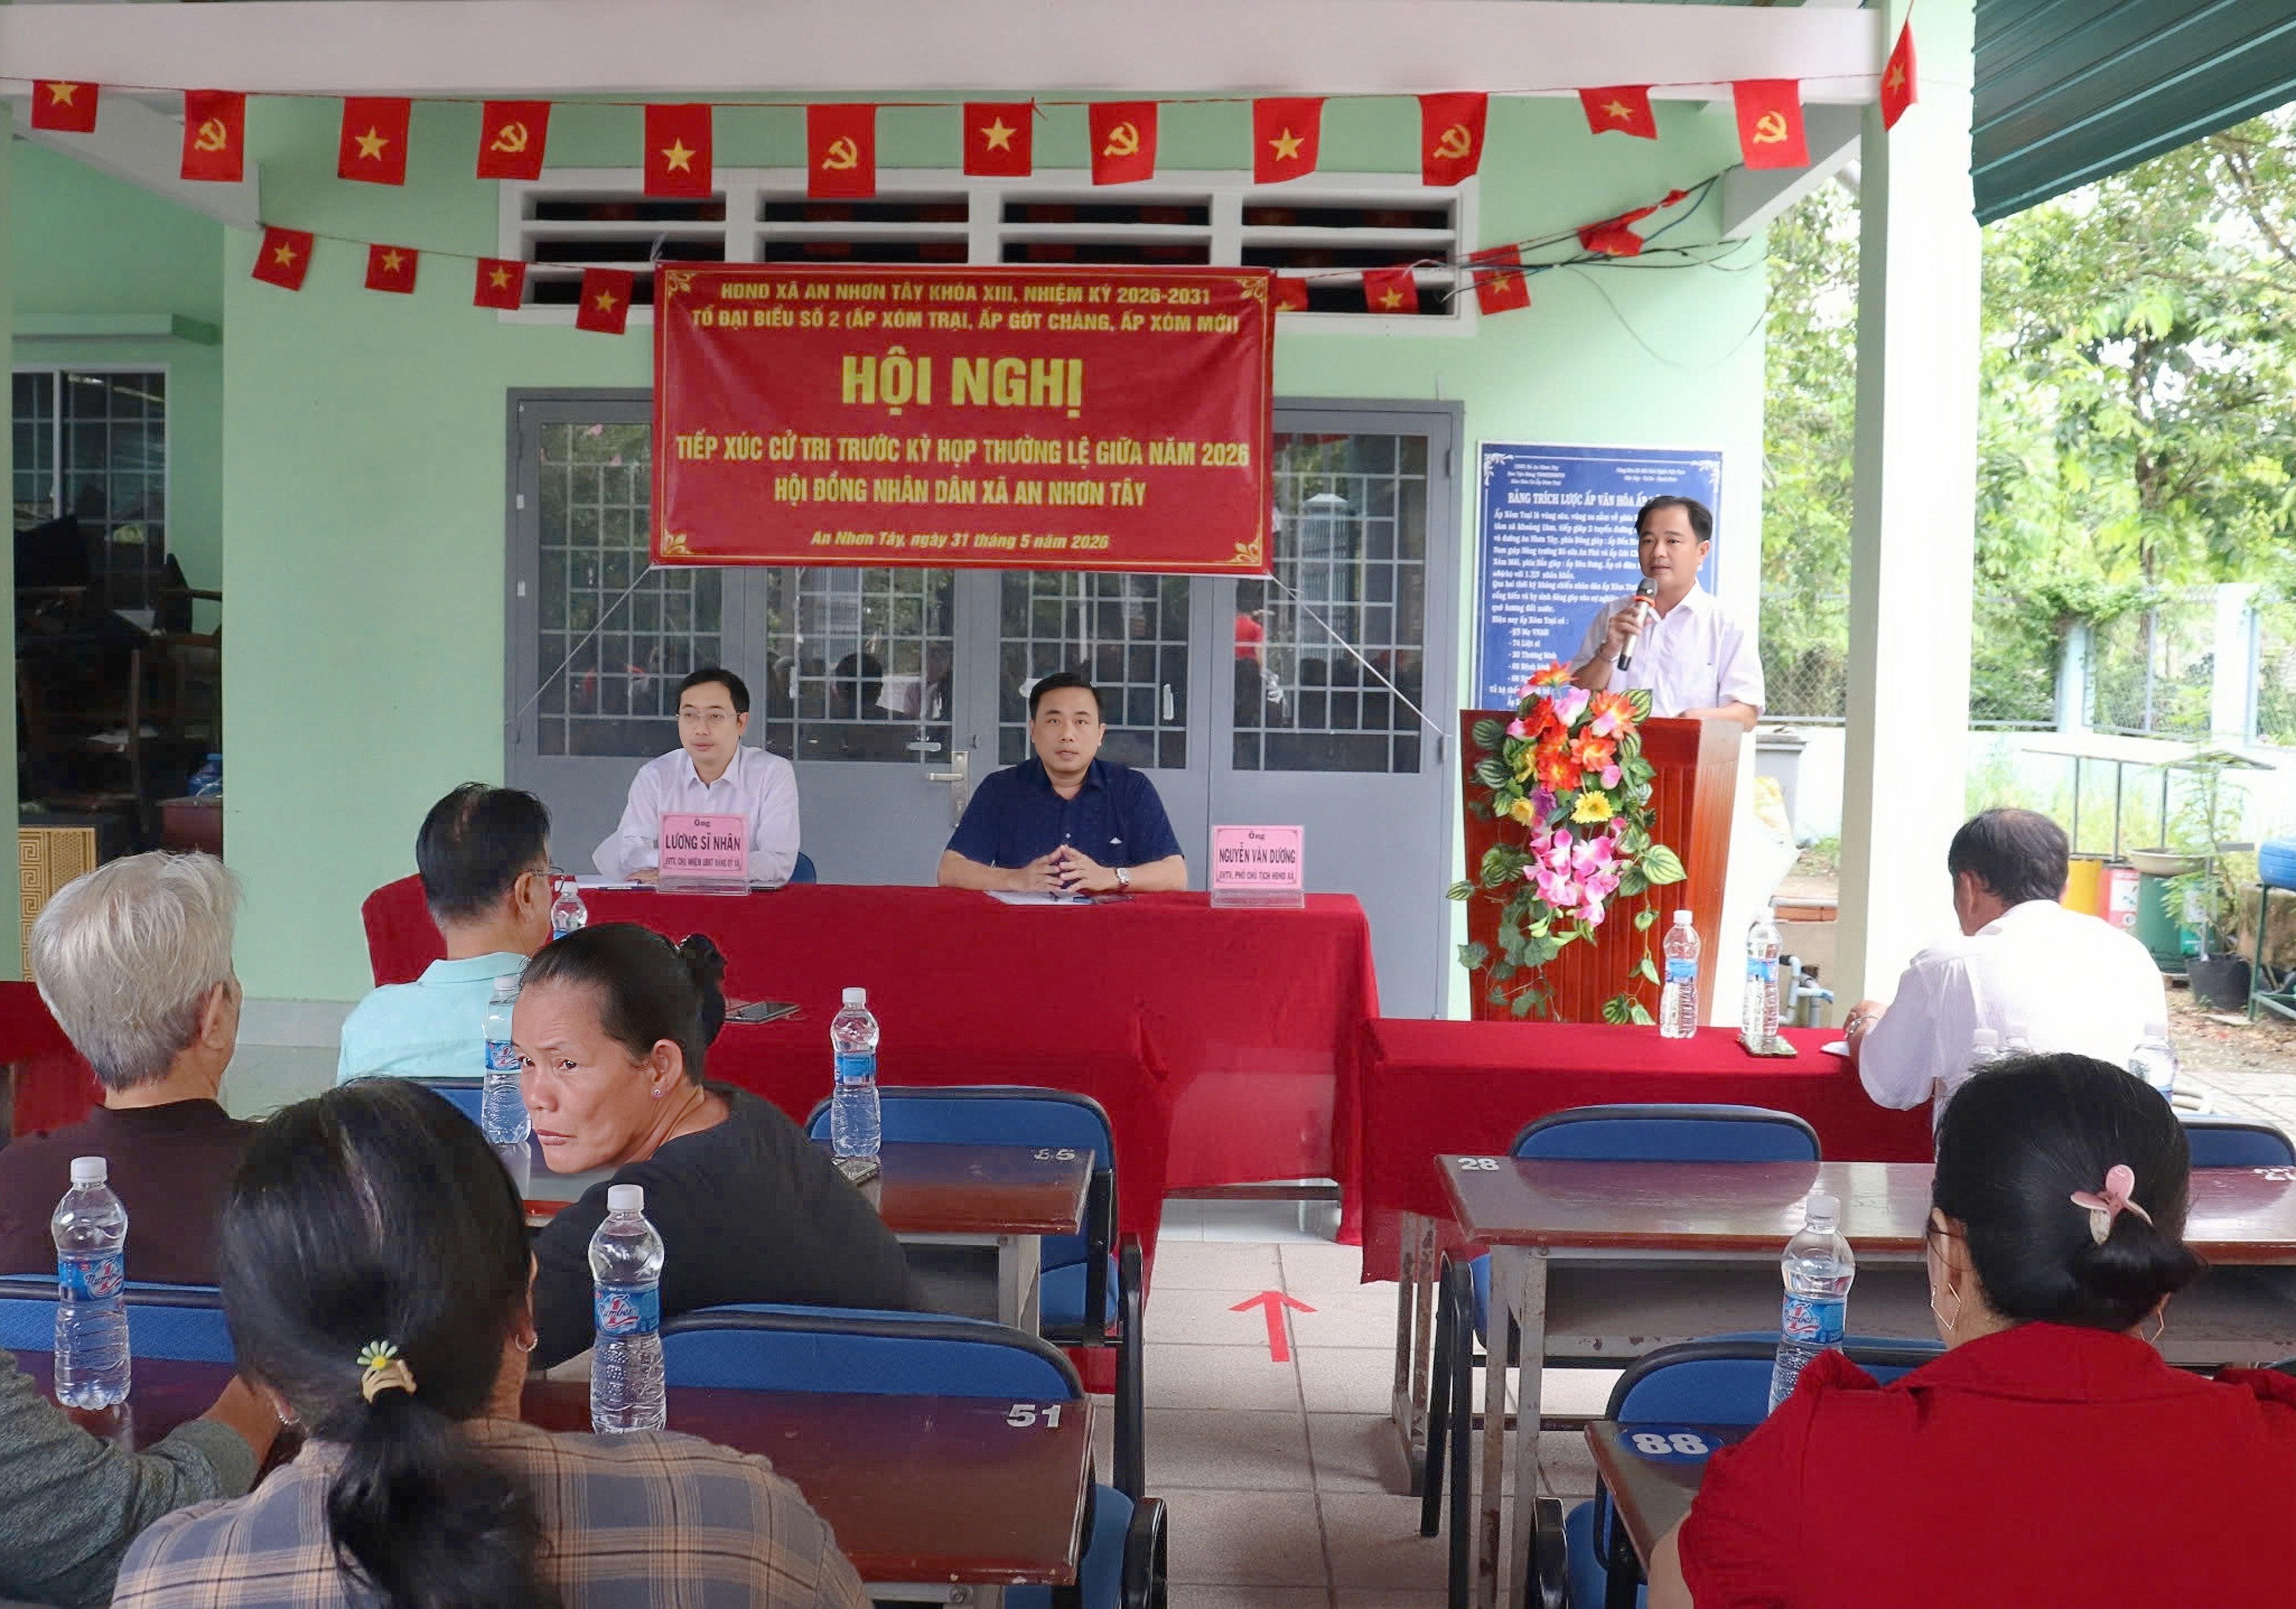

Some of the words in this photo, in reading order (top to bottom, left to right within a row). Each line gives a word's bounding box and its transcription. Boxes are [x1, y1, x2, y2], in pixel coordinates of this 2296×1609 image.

[776, 281, 799, 300] XÃ
[805, 284, 829, 300] AN
[836, 282, 886, 300] NHƠN
[891, 281, 923, 301] TÂY
[929, 282, 977, 301] KHÓA
[1024, 283, 1083, 305] NHIỆM
[1089, 282, 1111, 303] KỲ
[1117, 286, 1210, 305] 2026-2031
[754, 304, 794, 327] BIỂU
[800, 305, 824, 327] SỐ
[829, 310, 840, 326] 2
[845, 305, 876, 329] (ẤP
[882, 308, 923, 328] XÓM
[928, 312, 973, 332] TRẠI,
[979, 306, 1002, 330] ẤP
[1009, 309, 1042, 330] GÓT
[1120, 309, 1145, 331] ẤP
[1150, 312, 1191, 332] XÓM
[843, 345, 931, 416] HỘI
[952, 357, 1082, 418] NGHỊ
[676, 428, 718, 460] TIẾP
[723, 431, 763, 461] XÚC
[769, 429, 797, 461] CỬ
[800, 437, 831, 461] TRI
[837, 433, 900, 462] TRƯỚC
[906, 433, 932, 463] KỲ
[937, 438, 977, 469] HỌP
[983, 433, 1061, 465] THƯỜNG
[1067, 435, 1090, 470] LỆ
[1095, 436, 1144, 465] GIỮA
[1148, 436, 1196, 466] NĂM
[1201, 442, 1251, 467] 2026
[774, 472, 807, 507] HỘI
[813, 470, 867, 503] ĐỒNG
[873, 474, 929, 503] NHÂN
[934, 475, 976, 504] DÂN
[982, 475, 1009, 504] XÃ
[1013, 480, 1043, 505] AN
[1048, 479, 1105, 506] NHƠN
[1109, 476, 1147, 507] TÂY
[811, 531, 831, 545] An
[878, 531, 906, 549] Tây,
[910, 532, 948, 549] ngày
[951, 532, 969, 548] 31
[973, 532, 1016, 550] tháng
[1019, 534, 1030, 548] 5
[1033, 534, 1067, 549] năm
[1070, 535, 1110, 550] 2026
[714, 833, 740, 851] NHÂN
[1252, 846, 1267, 864] VĂN
[1458, 1157, 1500, 1171] 28
[1006, 1404, 1061, 1427] 51
[1632, 1433, 1709, 1454] 88
